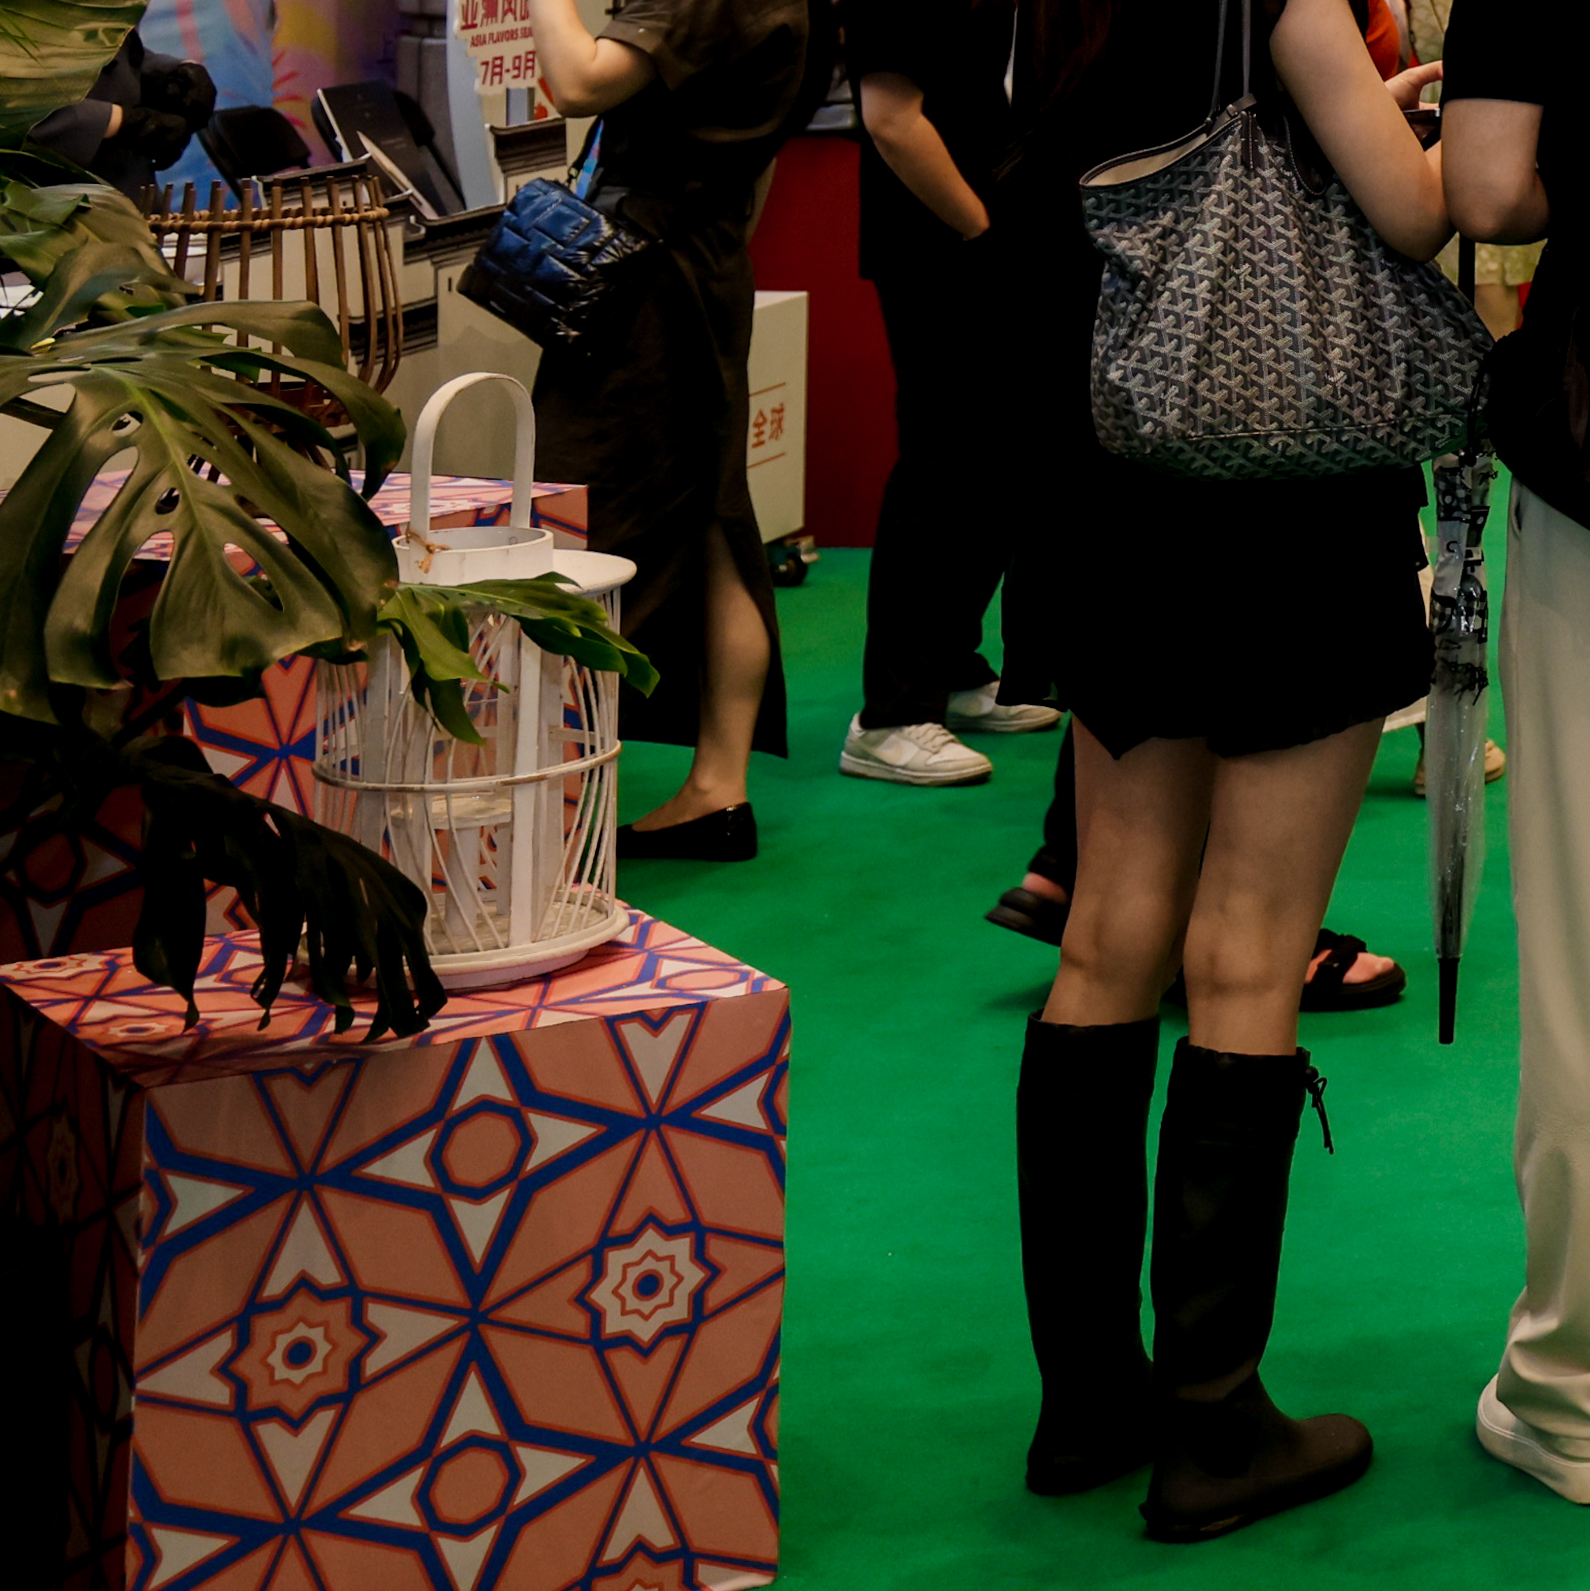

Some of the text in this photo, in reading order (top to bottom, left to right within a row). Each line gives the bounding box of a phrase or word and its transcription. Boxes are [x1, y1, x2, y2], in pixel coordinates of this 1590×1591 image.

[470, 34, 487, 47] ASIA
[480, 50, 536, 86] 7月-9月
[751, 403, 786, 449] 全球
